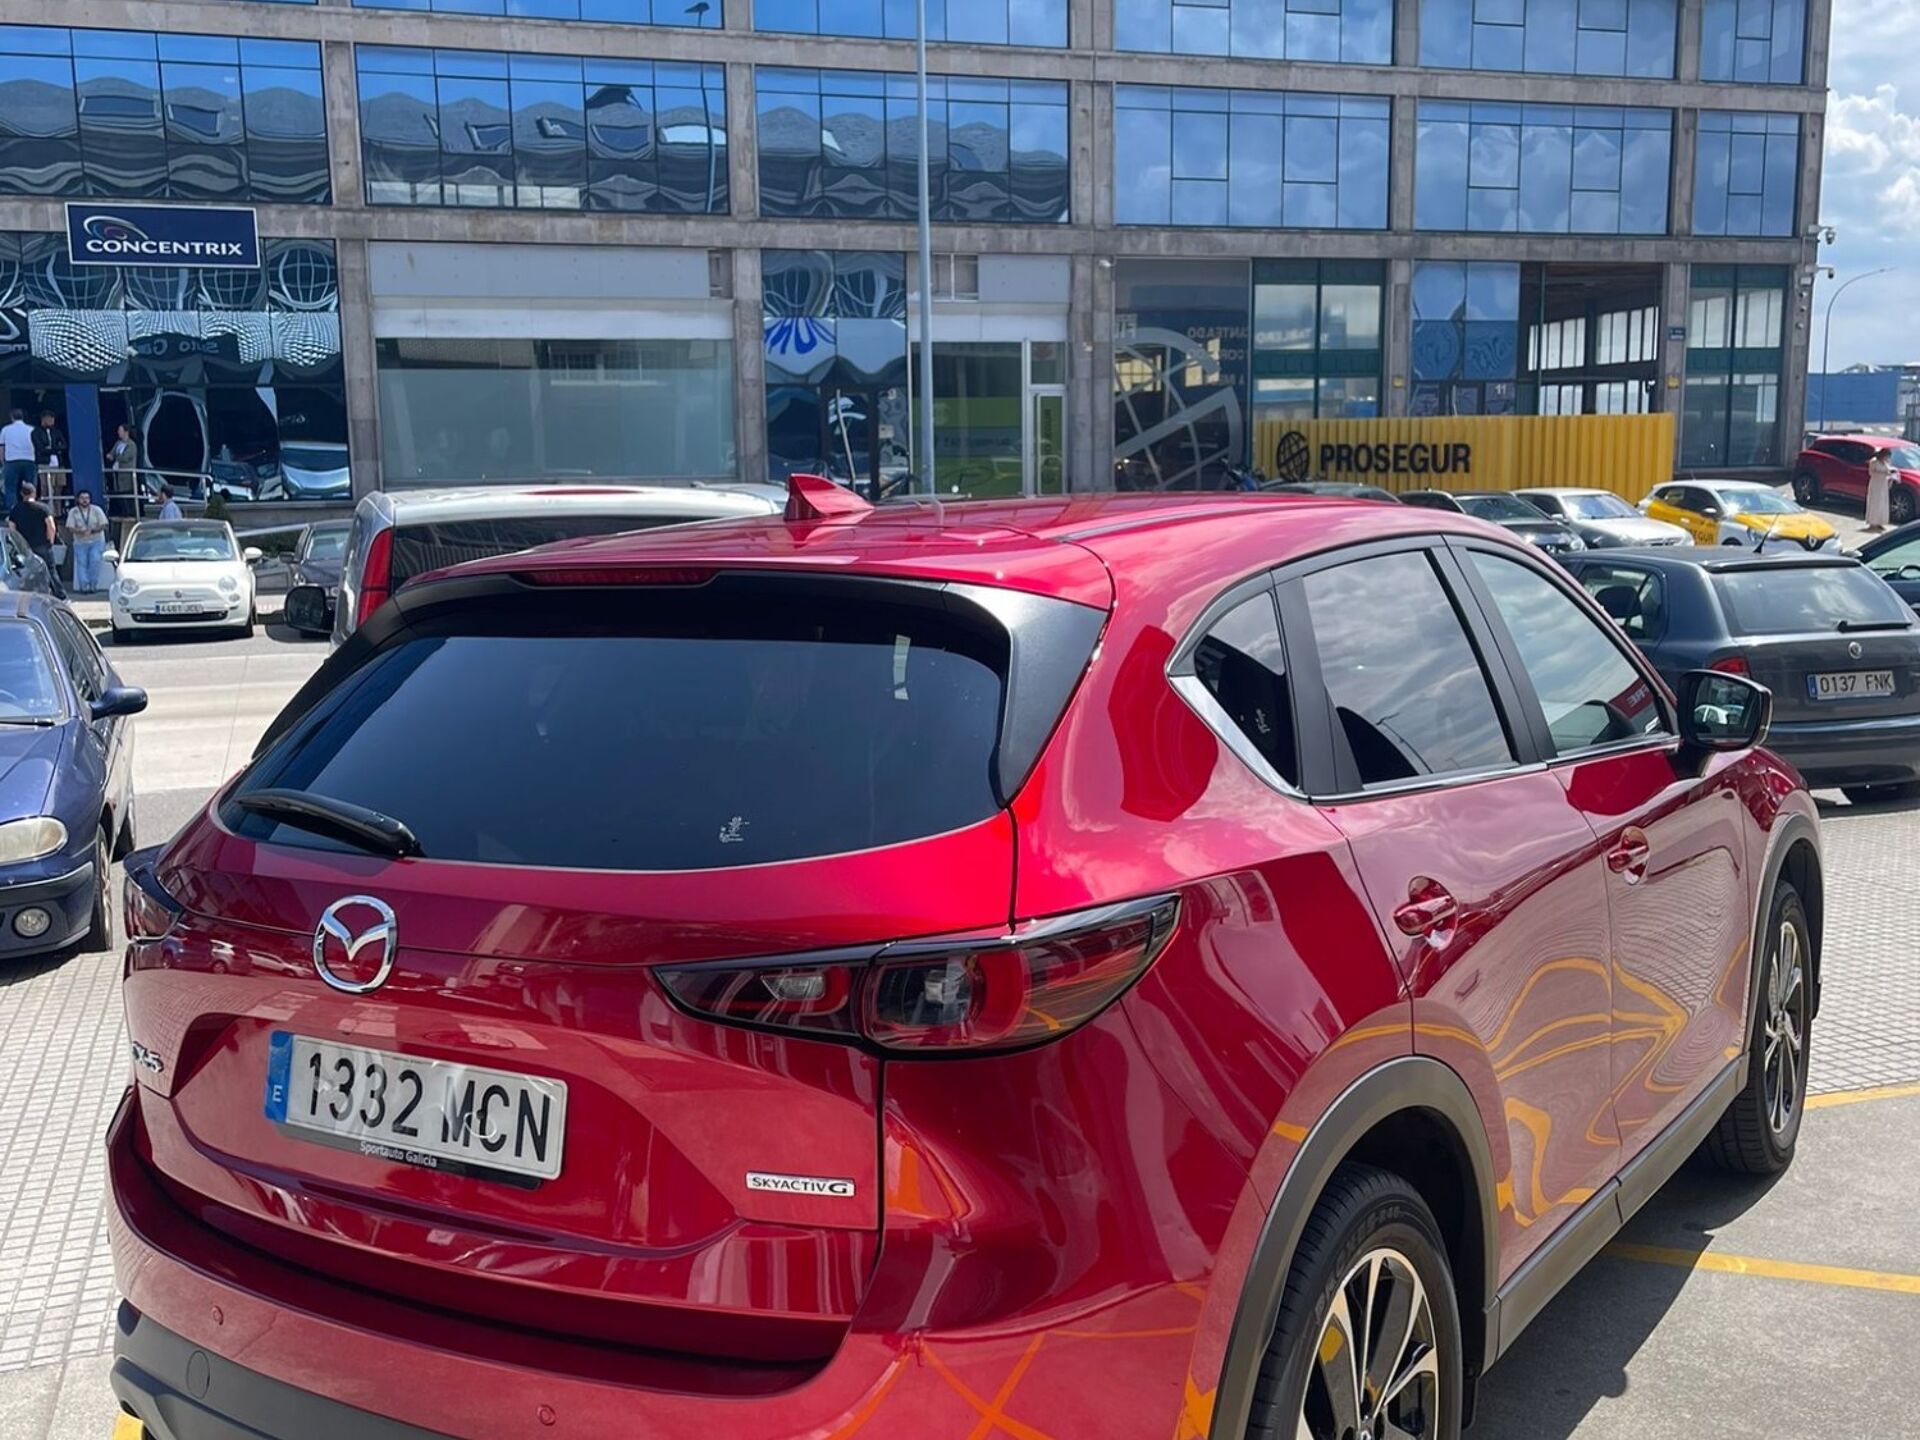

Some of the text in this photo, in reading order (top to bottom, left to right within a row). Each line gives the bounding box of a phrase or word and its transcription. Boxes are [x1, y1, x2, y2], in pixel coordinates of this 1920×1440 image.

[85, 239, 243, 256] CONCENTRIX
[1495, 383, 1506, 395] 11
[1319, 442, 1471, 474] PROSEGUR
[1820, 673, 1892, 693] 0137 FNK
[272, 1052, 551, 1163] E 1332 MCN
[360, 1140, 437, 1168] Sportauto Galicia
